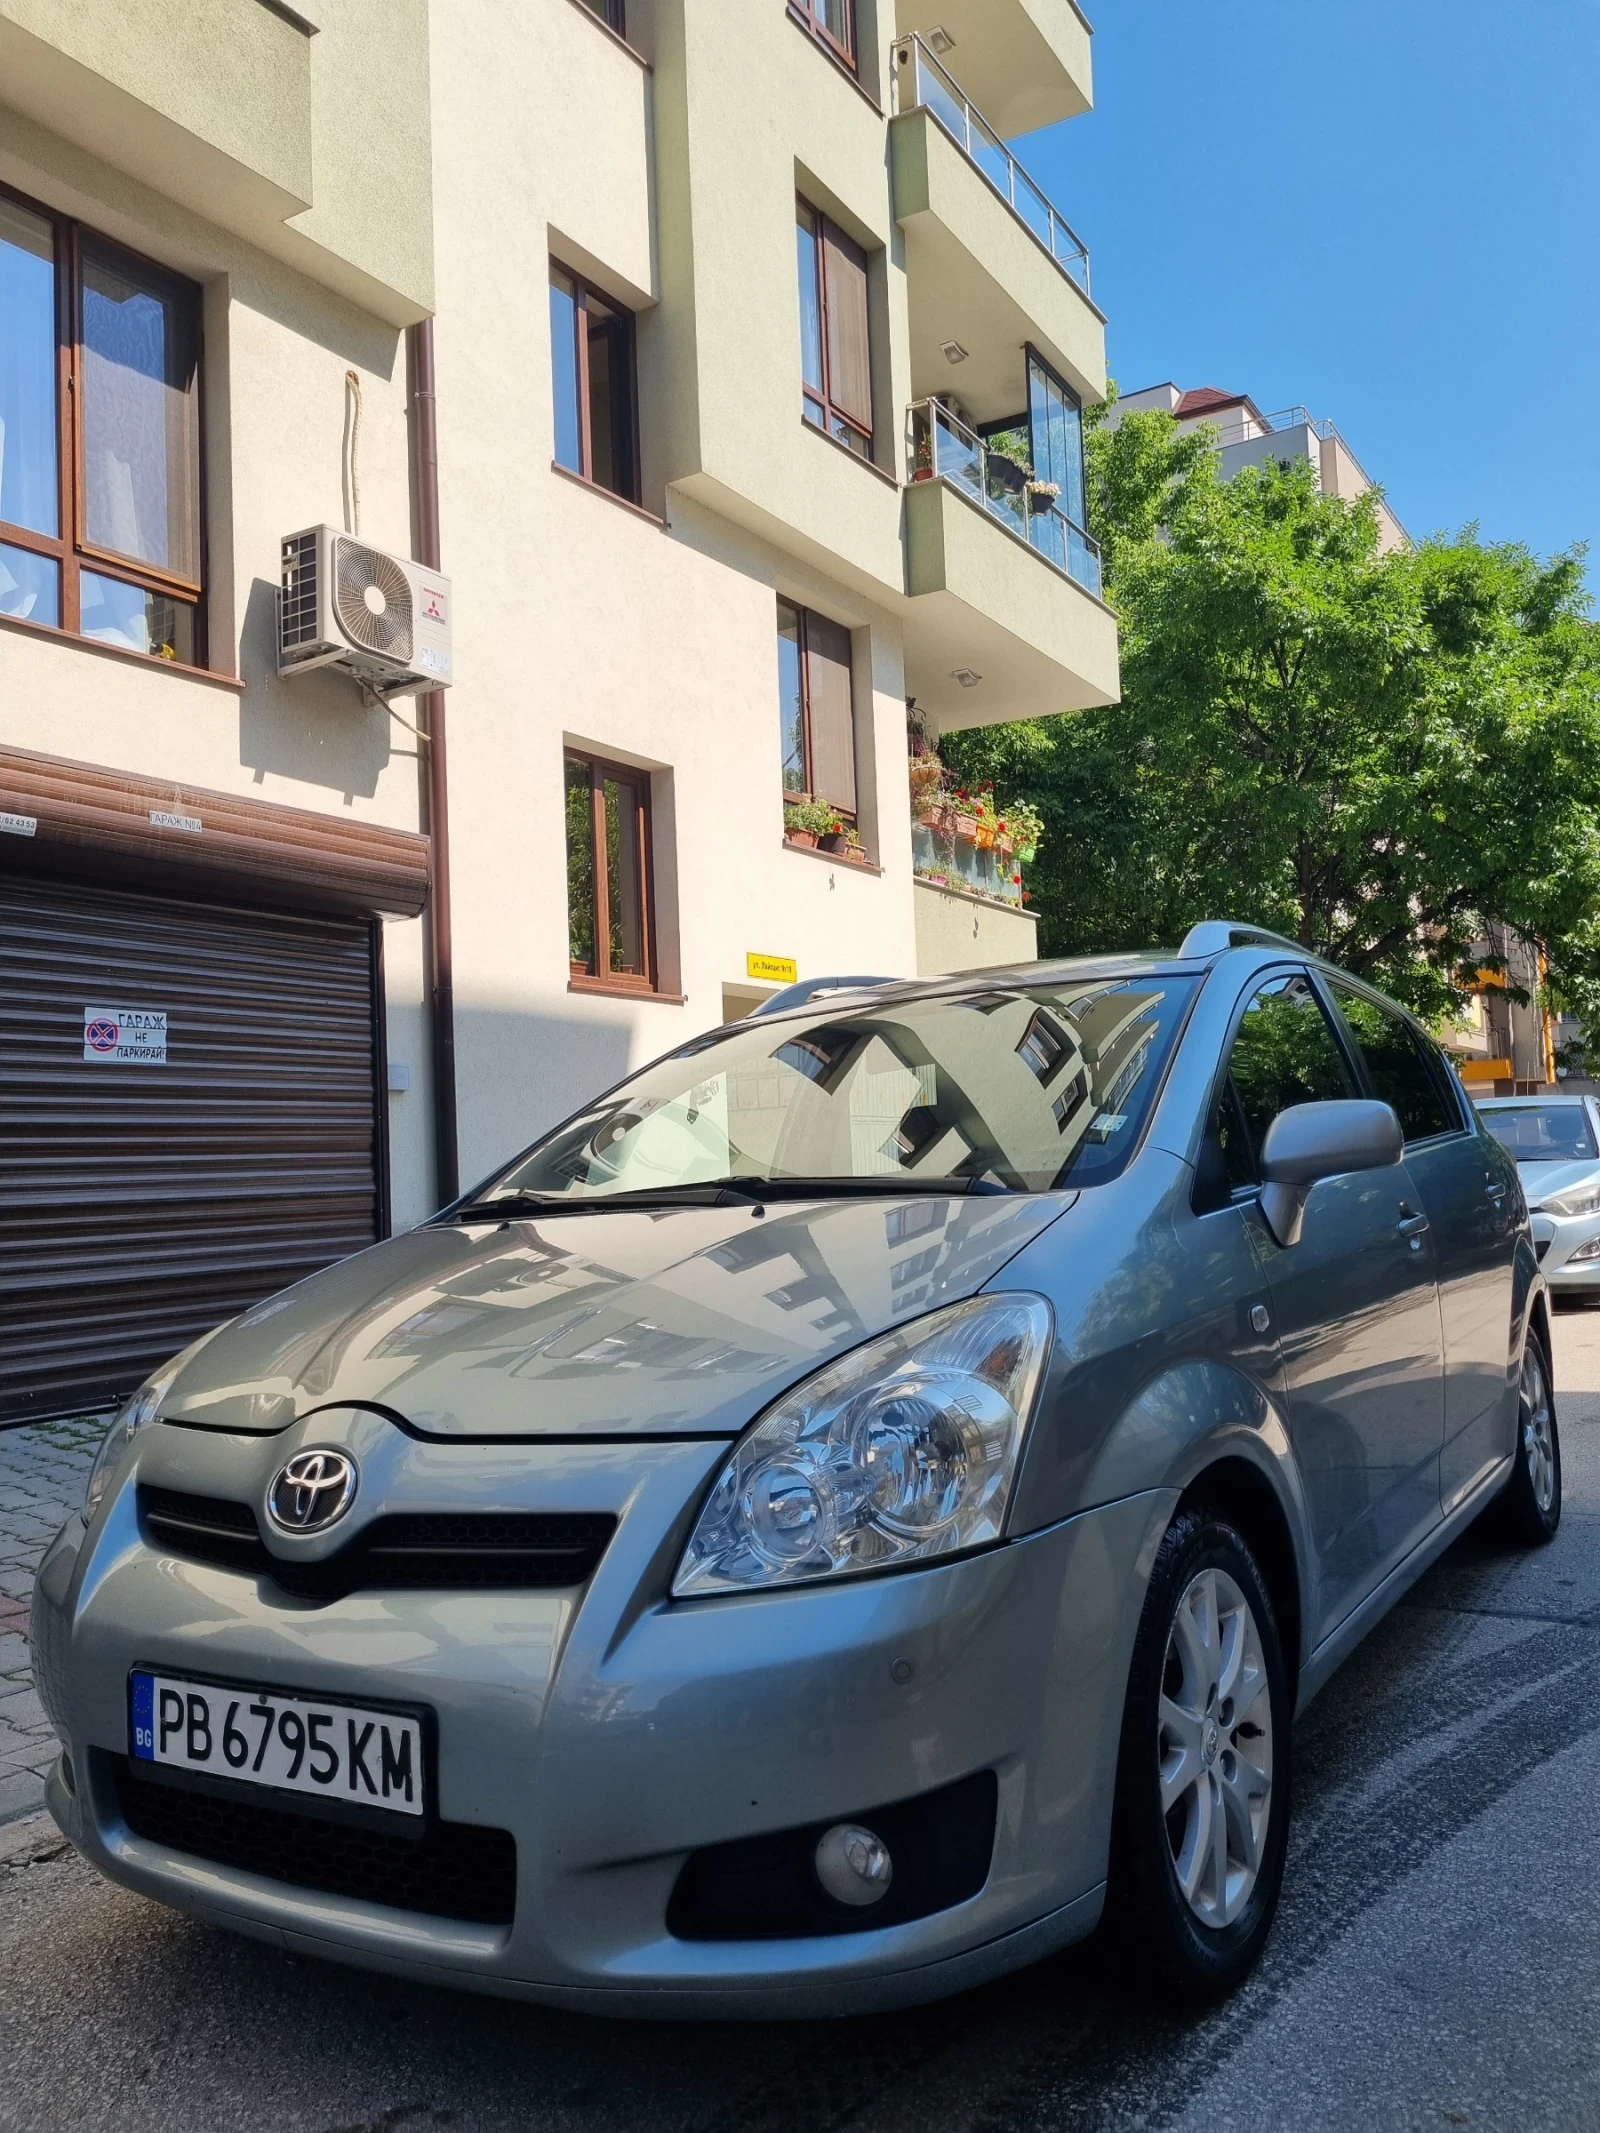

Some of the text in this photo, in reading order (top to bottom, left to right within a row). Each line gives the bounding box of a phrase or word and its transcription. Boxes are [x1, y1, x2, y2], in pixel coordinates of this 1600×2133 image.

[15, 819, 25, 827] 43
[26, 821, 35, 829] 53
[151, 812, 182, 828] ГАРАЖ
[118, 1013, 165, 1030] ГАРАЖ
[135, 1032, 148, 1043] НЕ
[116, 1045, 165, 1060] ПАРКИРАЙ!
[135, 1727, 152, 1748] BG
